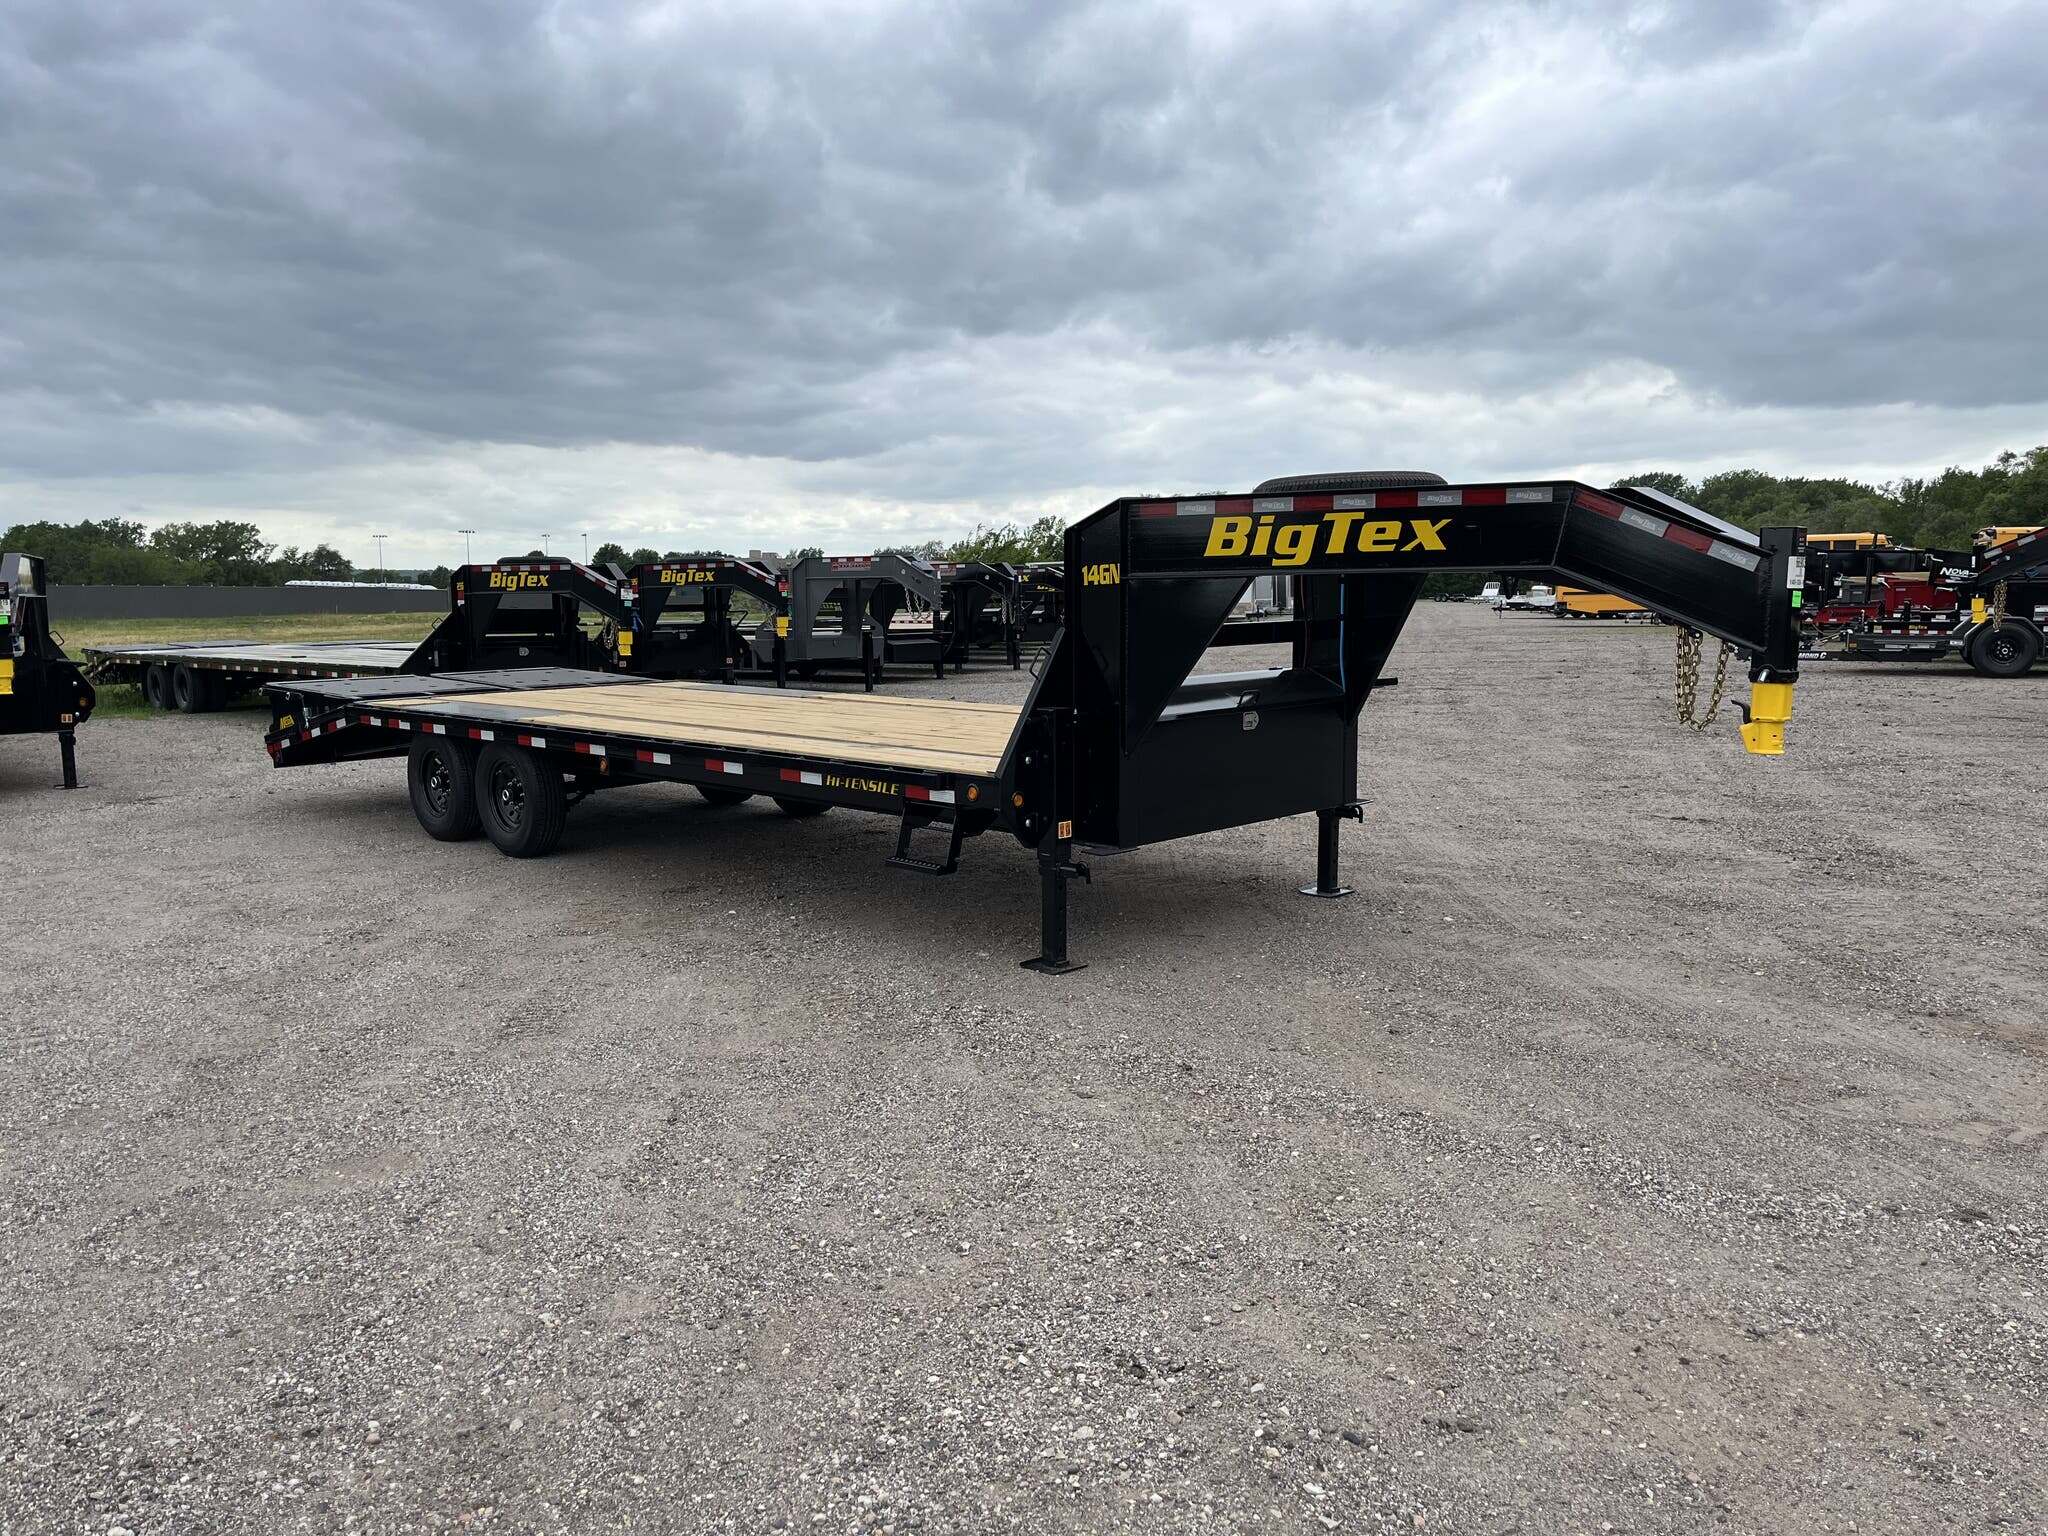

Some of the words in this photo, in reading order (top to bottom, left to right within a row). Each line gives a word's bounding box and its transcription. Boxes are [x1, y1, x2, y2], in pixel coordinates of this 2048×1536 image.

[1204, 511, 1453, 567] BigTex
[489, 571, 549, 591] BigTex
[660, 569, 715, 586] BigTex
[1081, 563, 1120, 586] 14GN
[1940, 567, 1969, 577] NOVA
[1798, 652, 1819, 660] MOND
[826, 774, 900, 795] HI-TENSILE
